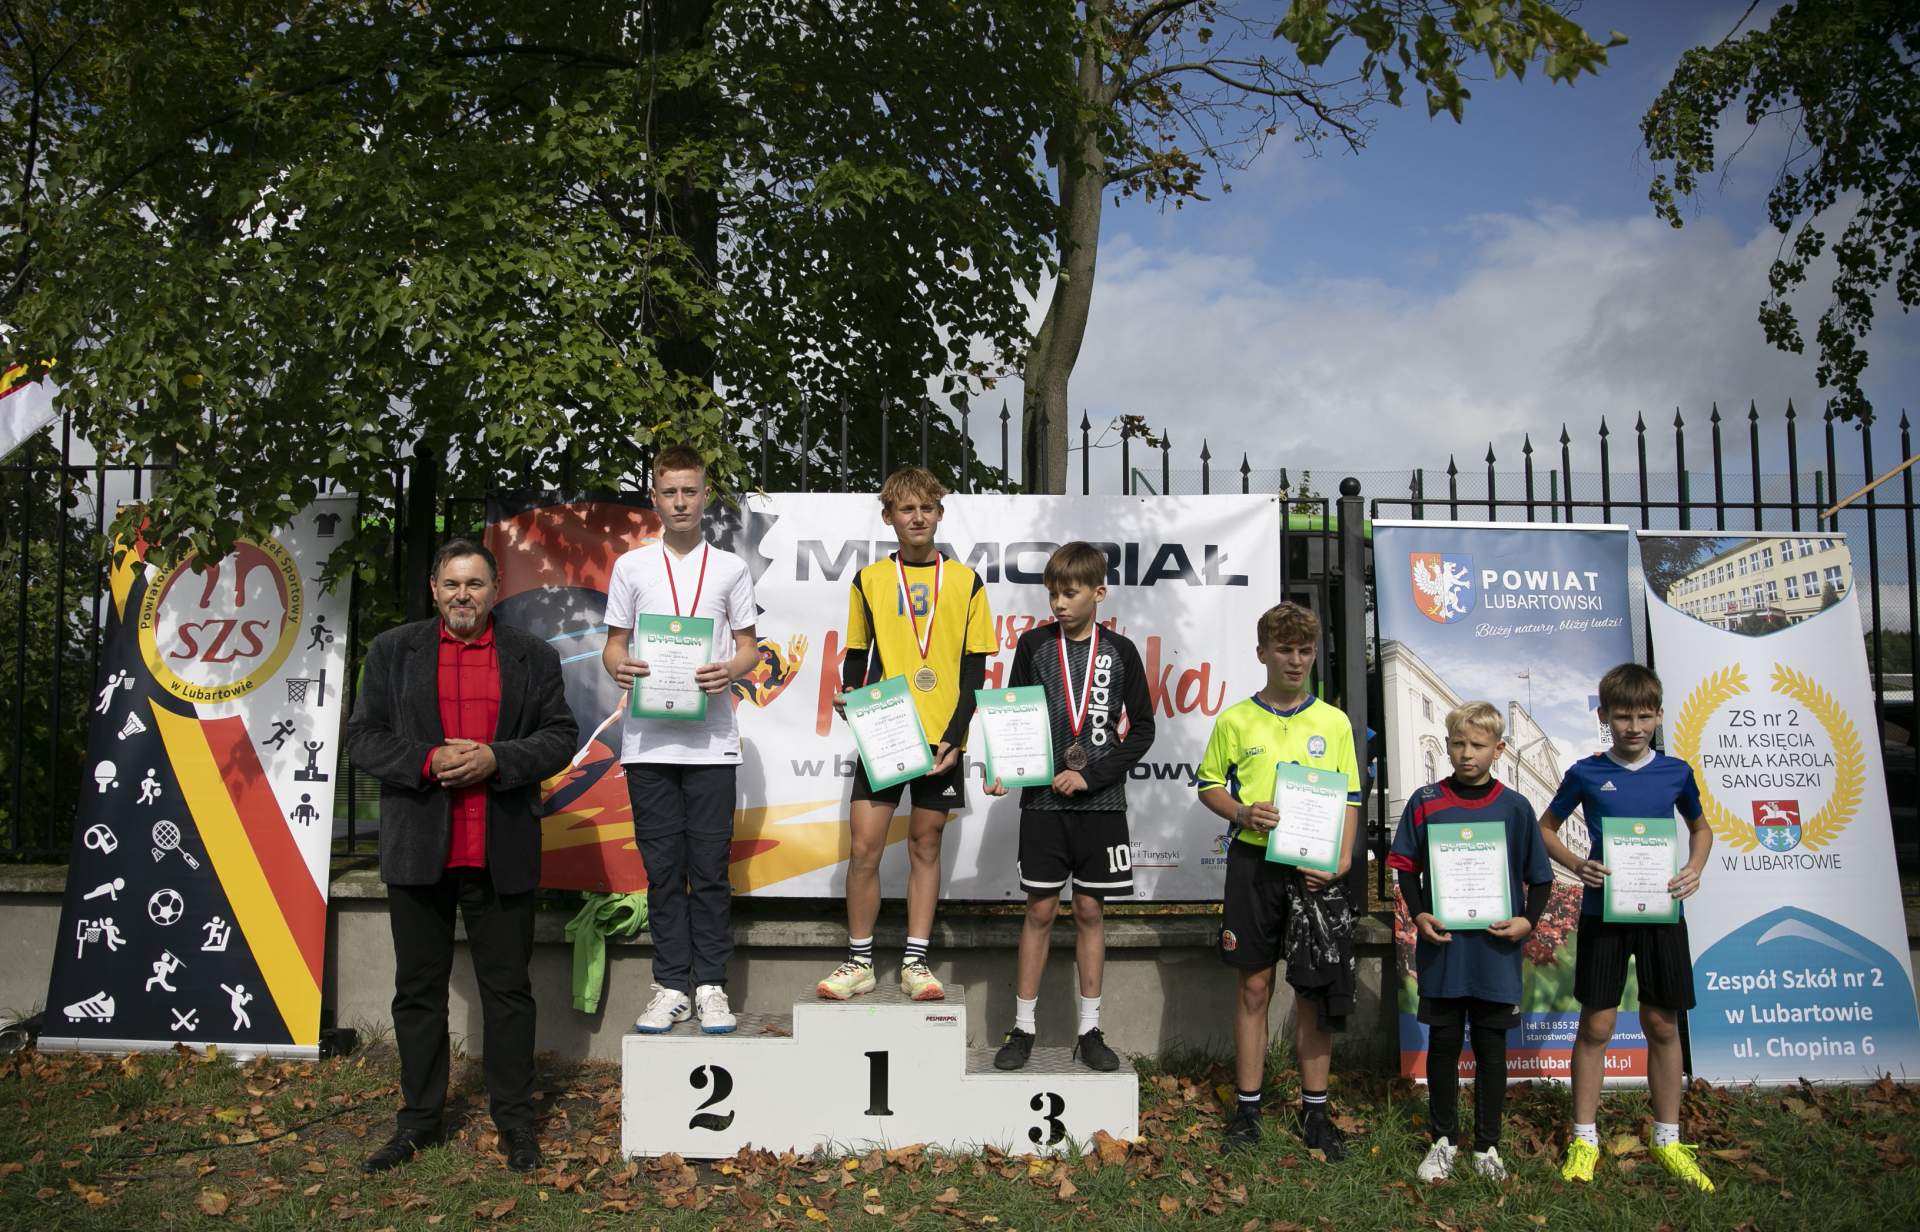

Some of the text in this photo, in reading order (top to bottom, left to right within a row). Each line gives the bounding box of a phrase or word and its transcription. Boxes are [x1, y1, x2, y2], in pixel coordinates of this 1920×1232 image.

[795, 540, 1249, 587] MMOIAŁ
[281, 556, 301, 624] Sportowy
[1481, 569, 1599, 592] POWIAT
[141, 566, 172, 630] Powiatow
[1484, 593, 1603, 610] LUBARTOWSKI
[1475, 616, 1623, 638] Bliżej natury, bliżej ludzi!
[169, 619, 271, 664] SZS
[647, 632, 702, 647] DYPLOM
[170, 679, 254, 700] w Lubartowie
[1088, 654, 1112, 747] adidas
[856, 695, 905, 718] DYPLOM
[1728, 709, 1799, 727] ZS nr 2
[1718, 733, 1815, 751] IM. KSIĘCIA
[790, 759, 825, 777] w
[1703, 752, 1835, 769] PAWŁA KAROLA
[1722, 773, 1821, 789] SANGUSZKI
[1106, 843, 1132, 874] 10
[1143, 850, 1180, 861] Turystyki
[1440, 841, 1496, 853] DYPLOM
[1721, 854, 1842, 871] W LUBARTOWIE
[1706, 967, 1885, 995] Zespół Szkół nr 2
[1724, 1001, 1873, 1024] w Lubartowie
[1539, 1021, 1551, 1030] 81
[1733, 1035, 1876, 1061] ul. Chopina 6
[863, 1050, 894, 1116] 1
[688, 1064, 735, 1132] 2
[1027, 1091, 1067, 1146] 3
